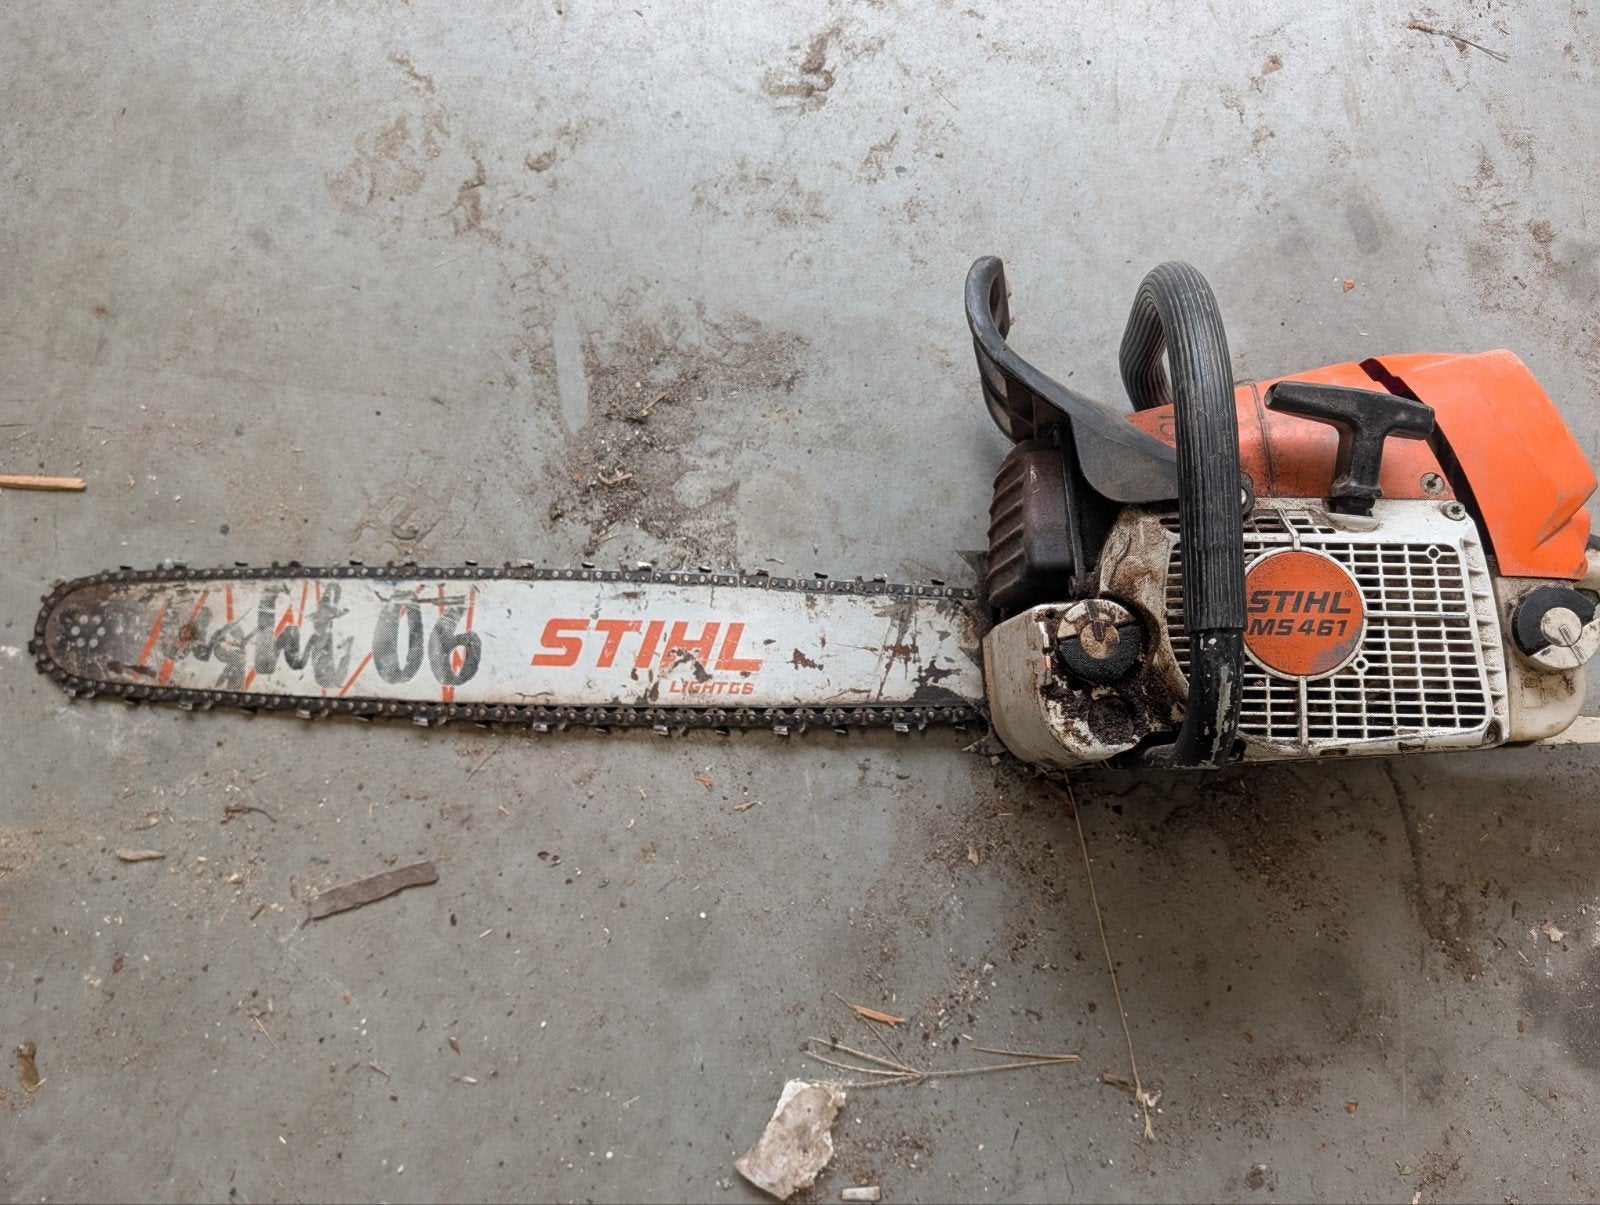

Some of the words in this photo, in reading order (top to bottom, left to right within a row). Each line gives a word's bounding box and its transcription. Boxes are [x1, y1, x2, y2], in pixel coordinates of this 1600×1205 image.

[1247, 590, 1351, 614] STIHL
[372, 590, 482, 686] 06
[531, 618, 763, 672] STIHL
[1249, 618, 1294, 636] MS
[1297, 619, 1348, 637] 461
